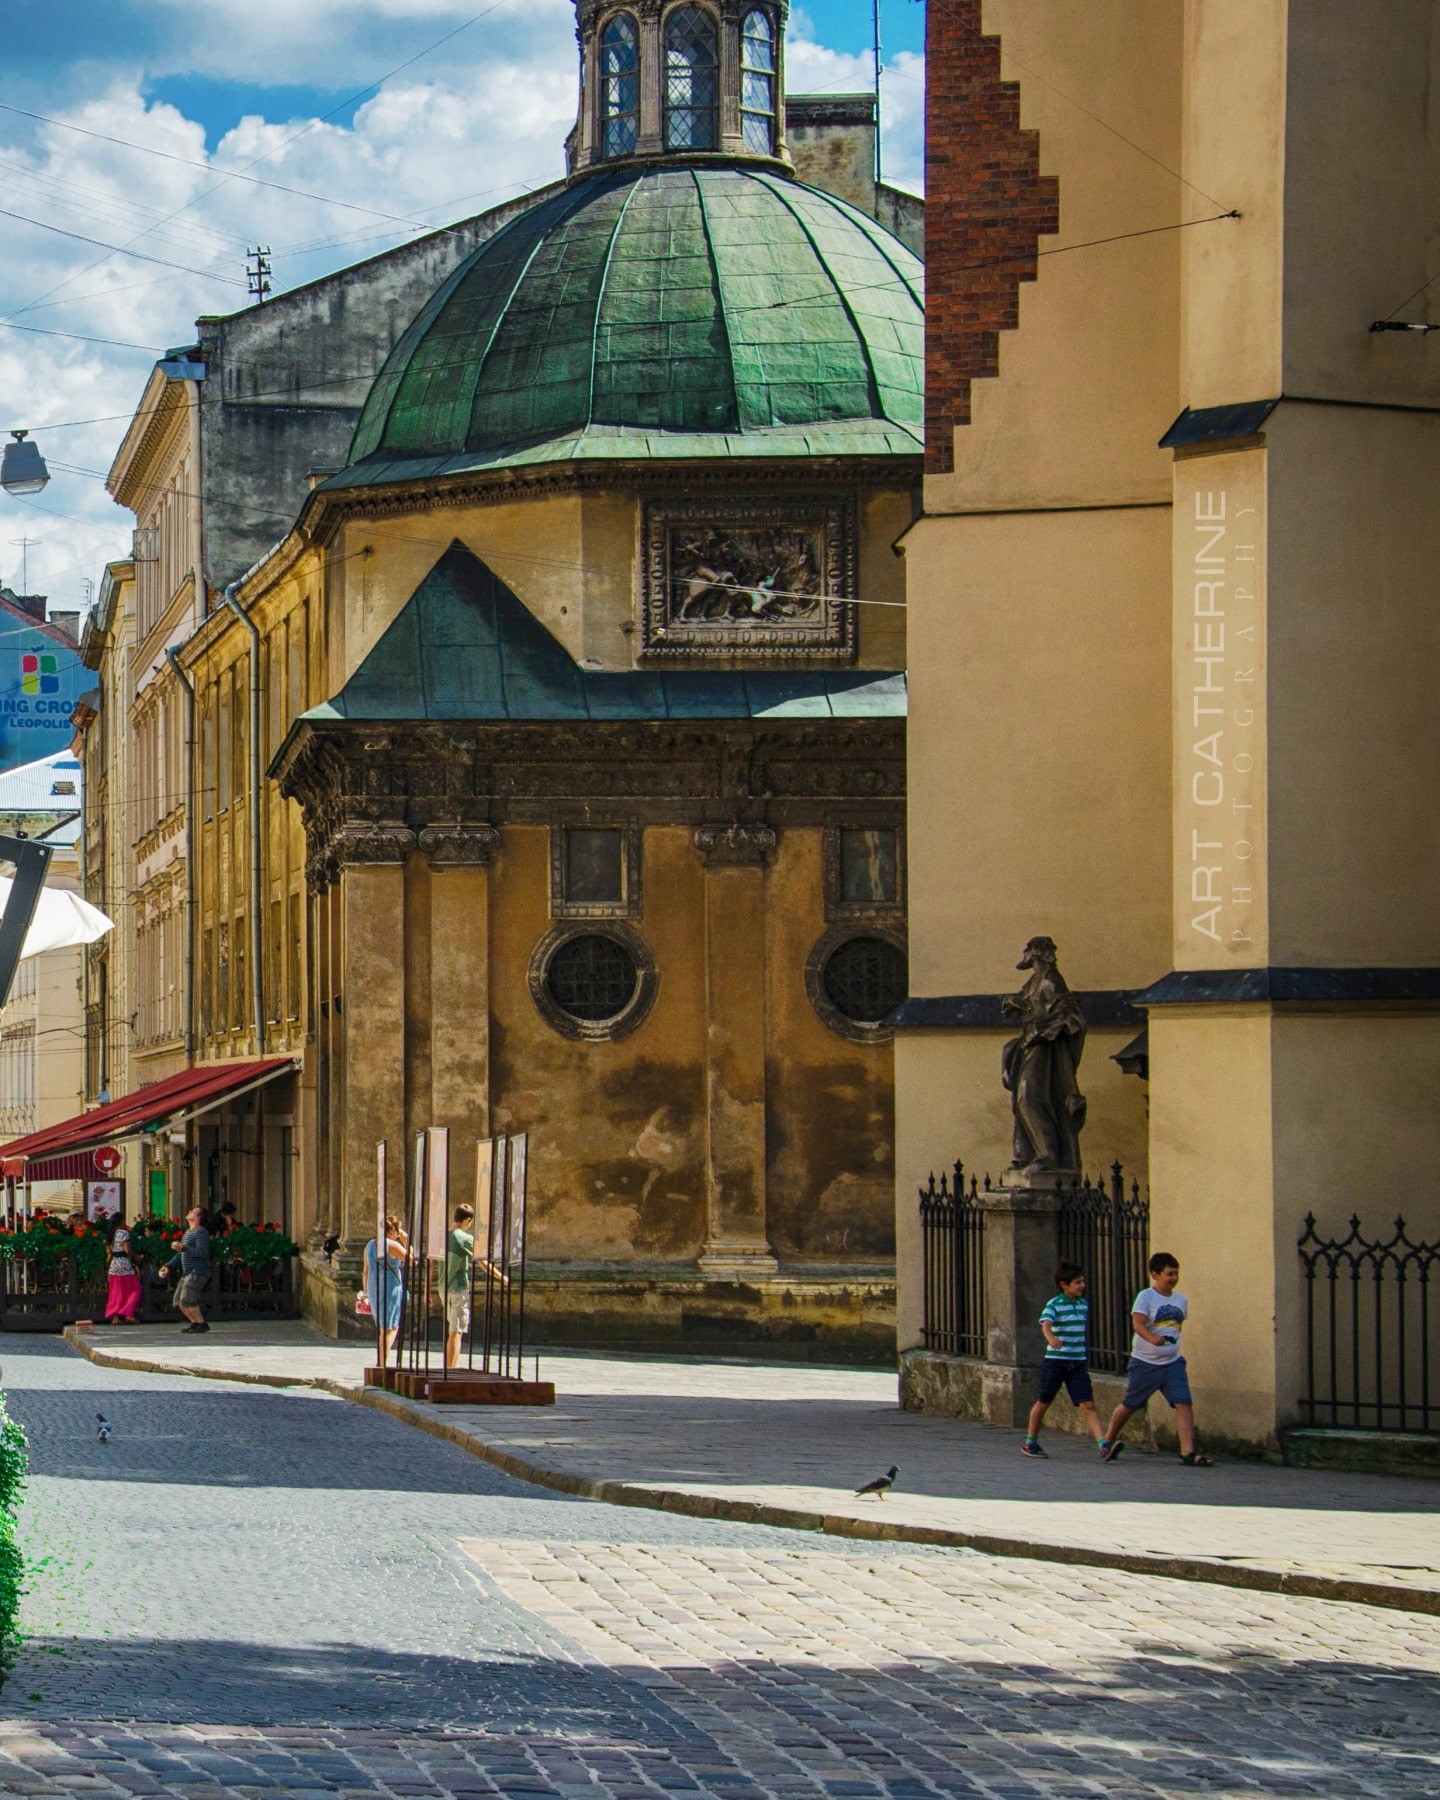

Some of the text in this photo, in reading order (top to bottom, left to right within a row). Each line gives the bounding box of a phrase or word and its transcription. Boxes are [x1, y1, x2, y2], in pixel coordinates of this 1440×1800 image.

[9, 718, 71, 729] LEOPOLIS
[1191, 490, 1226, 942] ART CATHERINE
[1232, 502, 1256, 943] PHOTOGRAPHY
